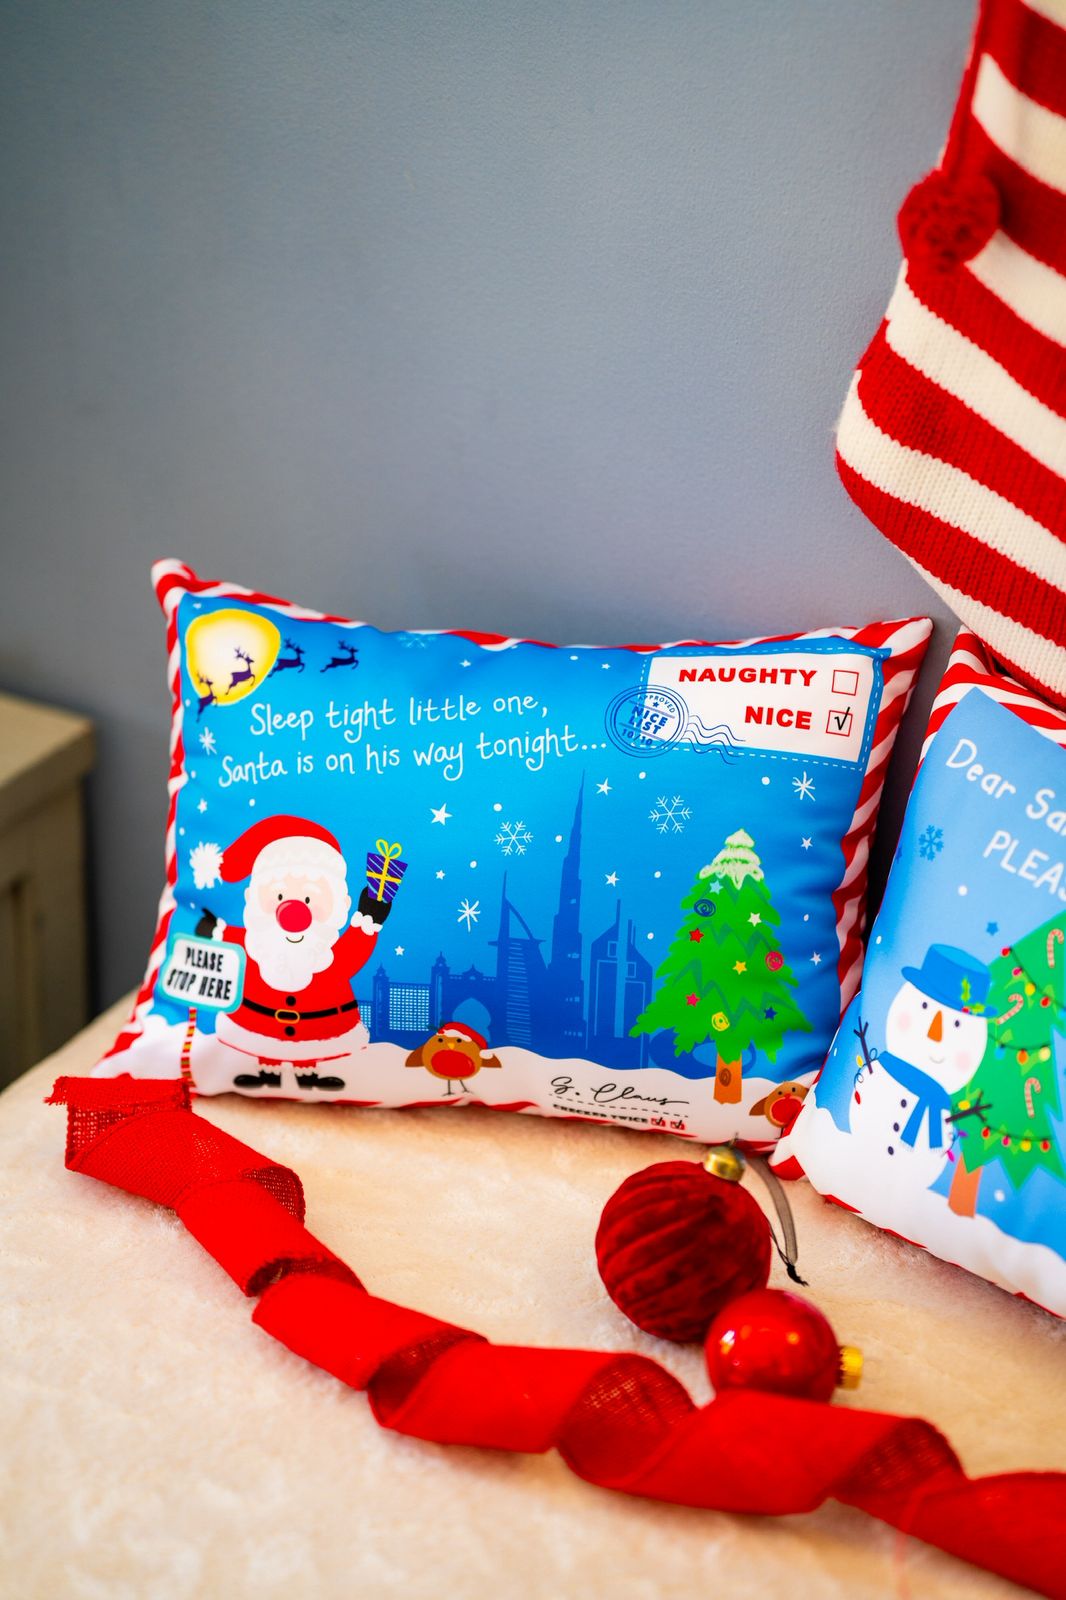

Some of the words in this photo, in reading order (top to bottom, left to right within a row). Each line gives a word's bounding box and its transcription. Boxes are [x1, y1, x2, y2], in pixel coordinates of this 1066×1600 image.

[678, 668, 817, 686] NAUGHTY
[250, 702, 314, 741] Sleep
[325, 698, 396, 743] tight
[409, 695, 481, 725] little
[493, 695, 548, 718] one,
[628, 716, 661, 734] LIST
[632, 706, 668, 727] NICE
[744, 706, 812, 730] NICE
[622, 729, 653, 746] 10/10
[218, 751, 288, 788] Santa
[297, 752, 314, 774] is
[325, 753, 355, 774] on
[366, 744, 400, 774] his
[413, 742, 463, 781] way
[476, 725, 607, 771] tonight...
[945, 738, 1017, 799] Dear
[1025, 788, 1066, 836] Sa
[185, 947, 224, 972] PLEASE
[167, 968, 197, 992] STOP
[198, 976, 232, 1000] HERE
[590, 1083, 690, 1105] Claus
[611, 1114, 648, 1124] TWICE
